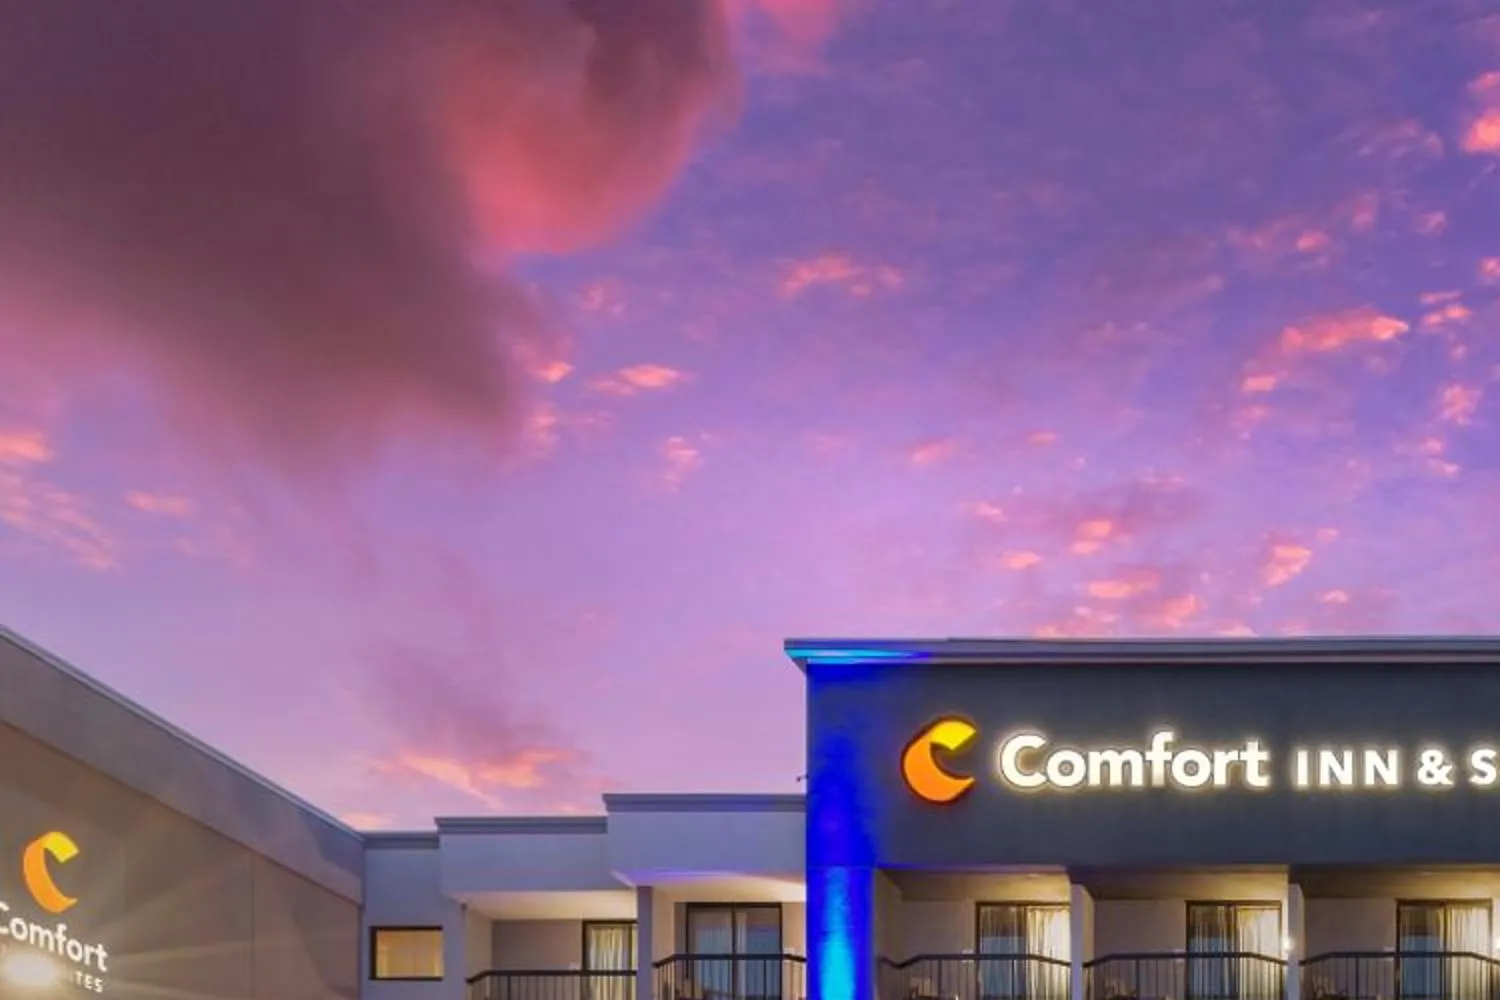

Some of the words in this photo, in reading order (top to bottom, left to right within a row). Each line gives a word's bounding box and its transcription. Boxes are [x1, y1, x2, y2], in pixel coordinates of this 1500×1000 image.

[1001, 731, 1270, 788] Comfort
[1297, 749, 1398, 785] INN
[1417, 749, 1453, 785] &
